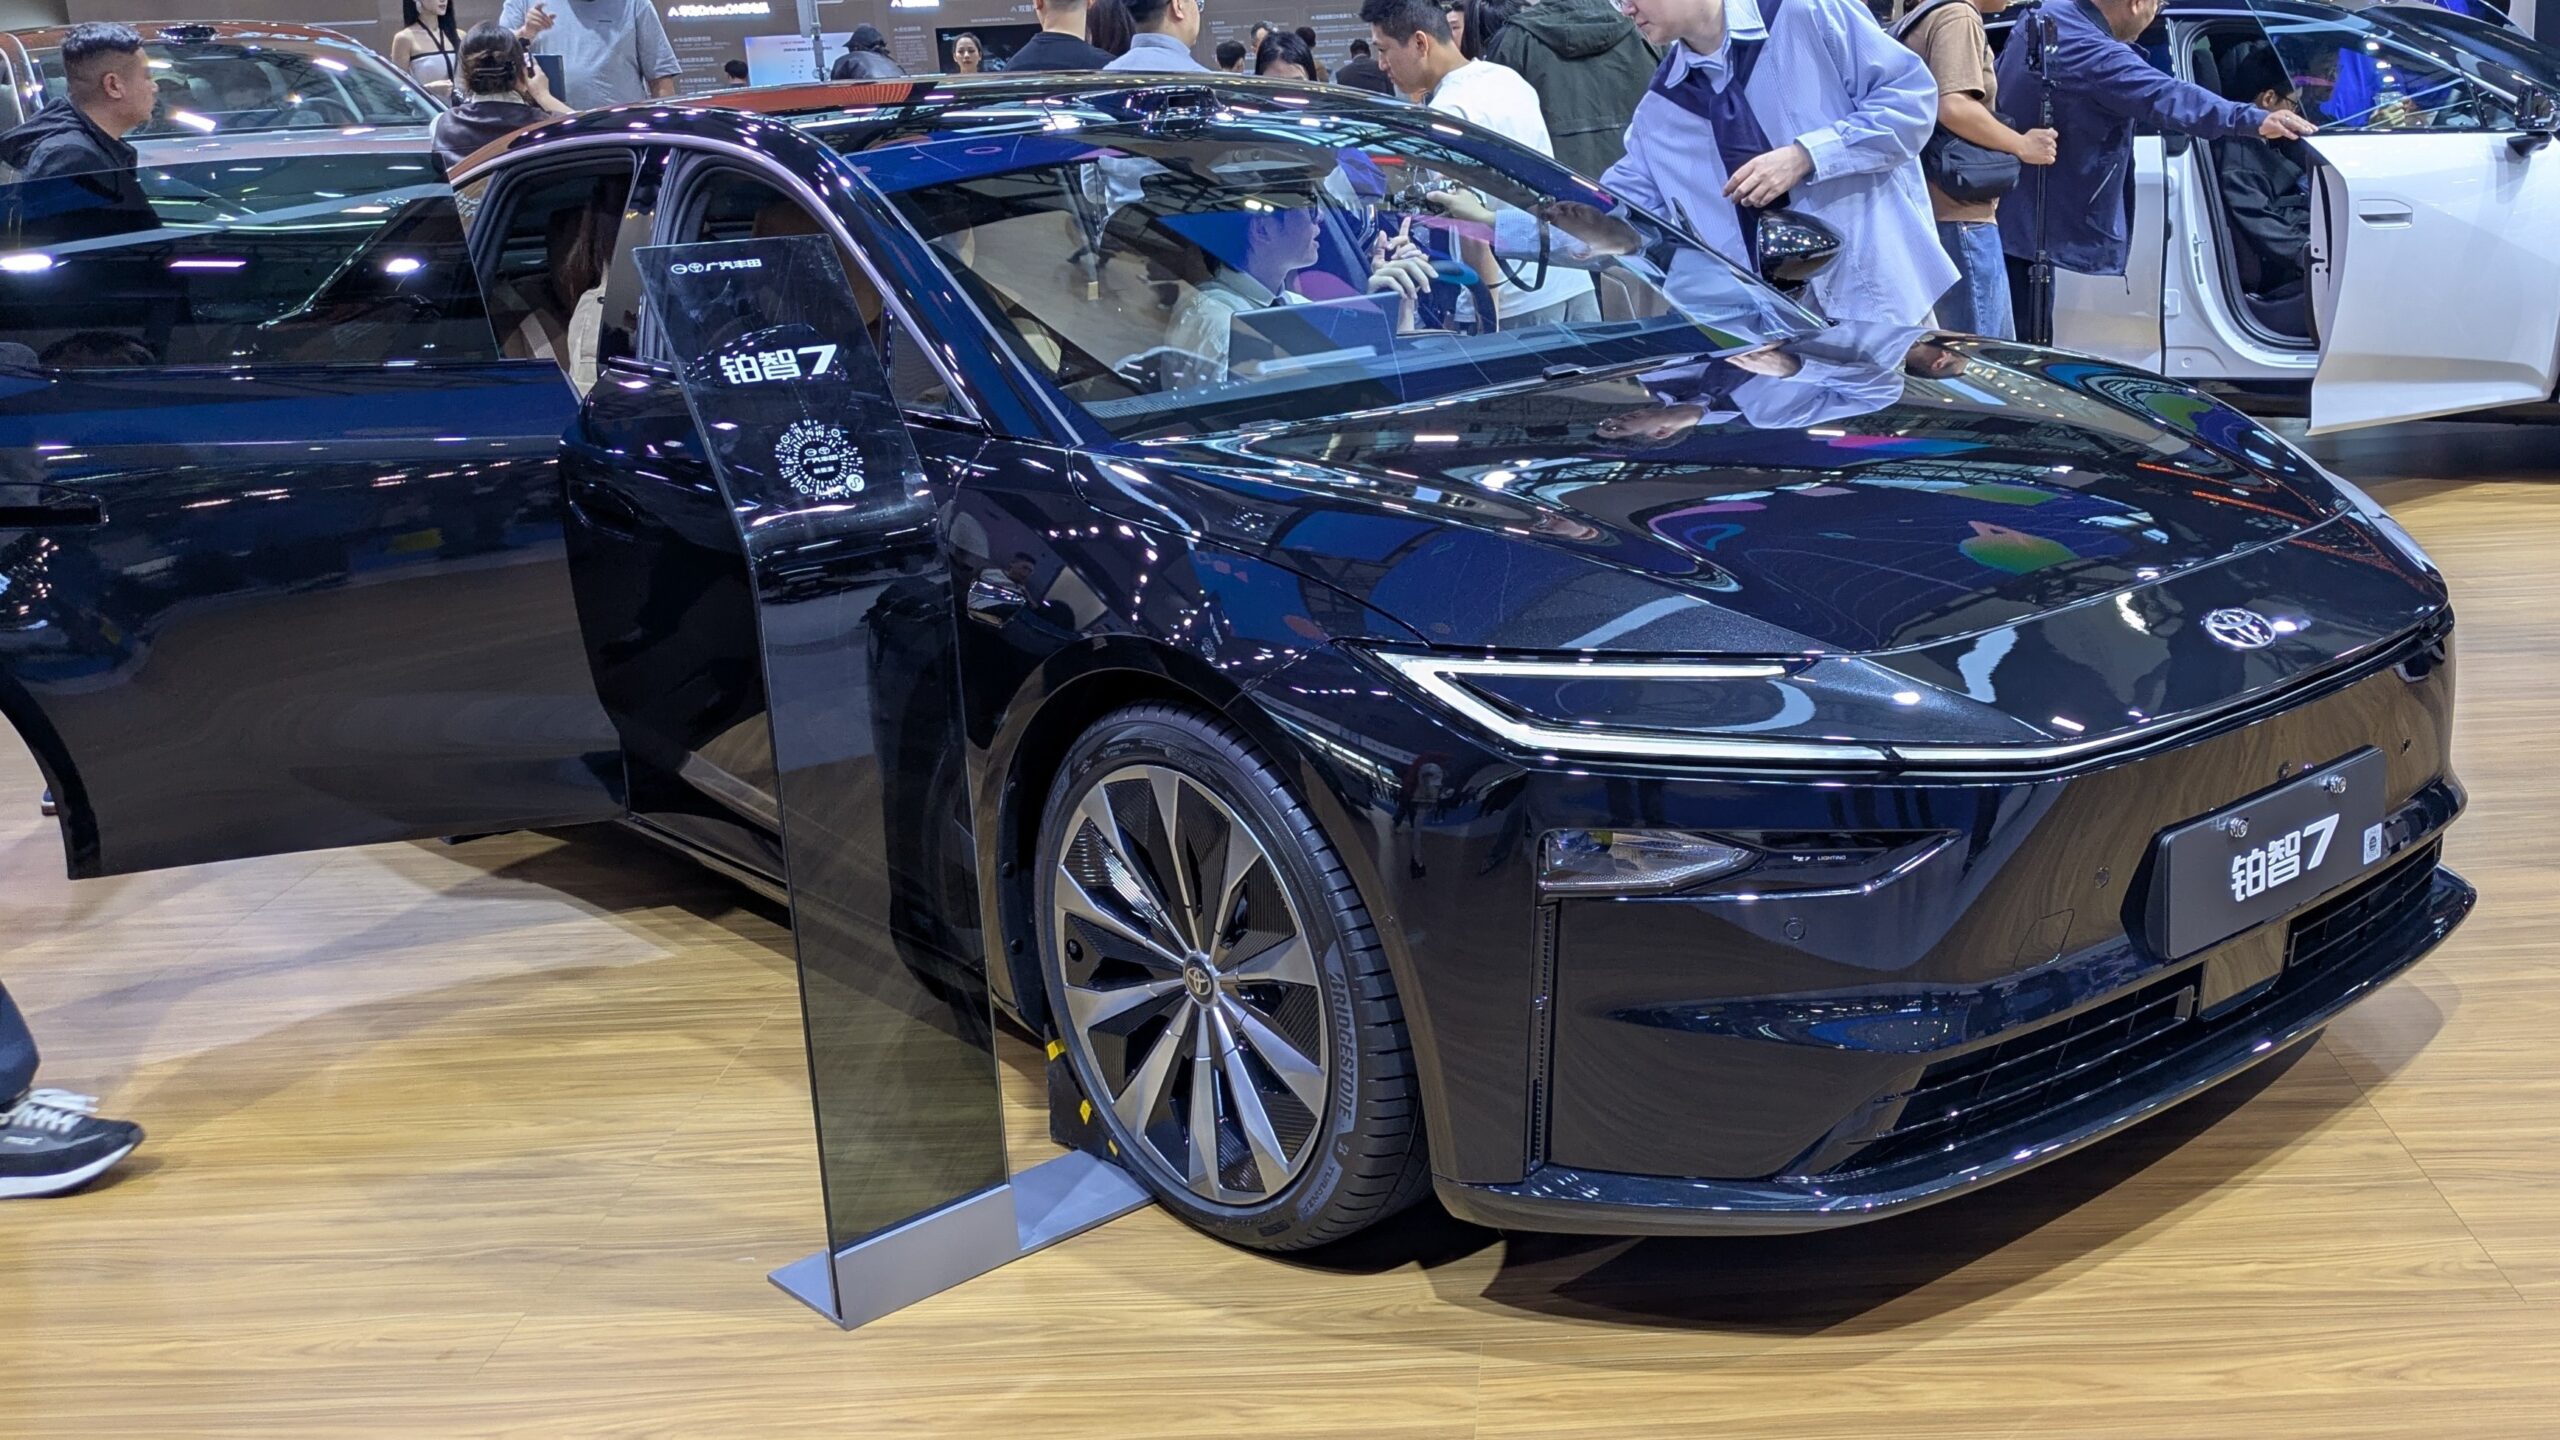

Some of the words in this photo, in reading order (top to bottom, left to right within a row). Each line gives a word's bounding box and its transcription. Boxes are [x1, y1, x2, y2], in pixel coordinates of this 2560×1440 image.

[705, 258, 763, 272] 广汽丰田
[719, 344, 837, 384] 铂智7
[2231, 813, 2340, 902] 铂智7
[1327, 971, 1354, 1121] BRIDGESTONE
[1303, 1166, 1336, 1214] TURANZA
